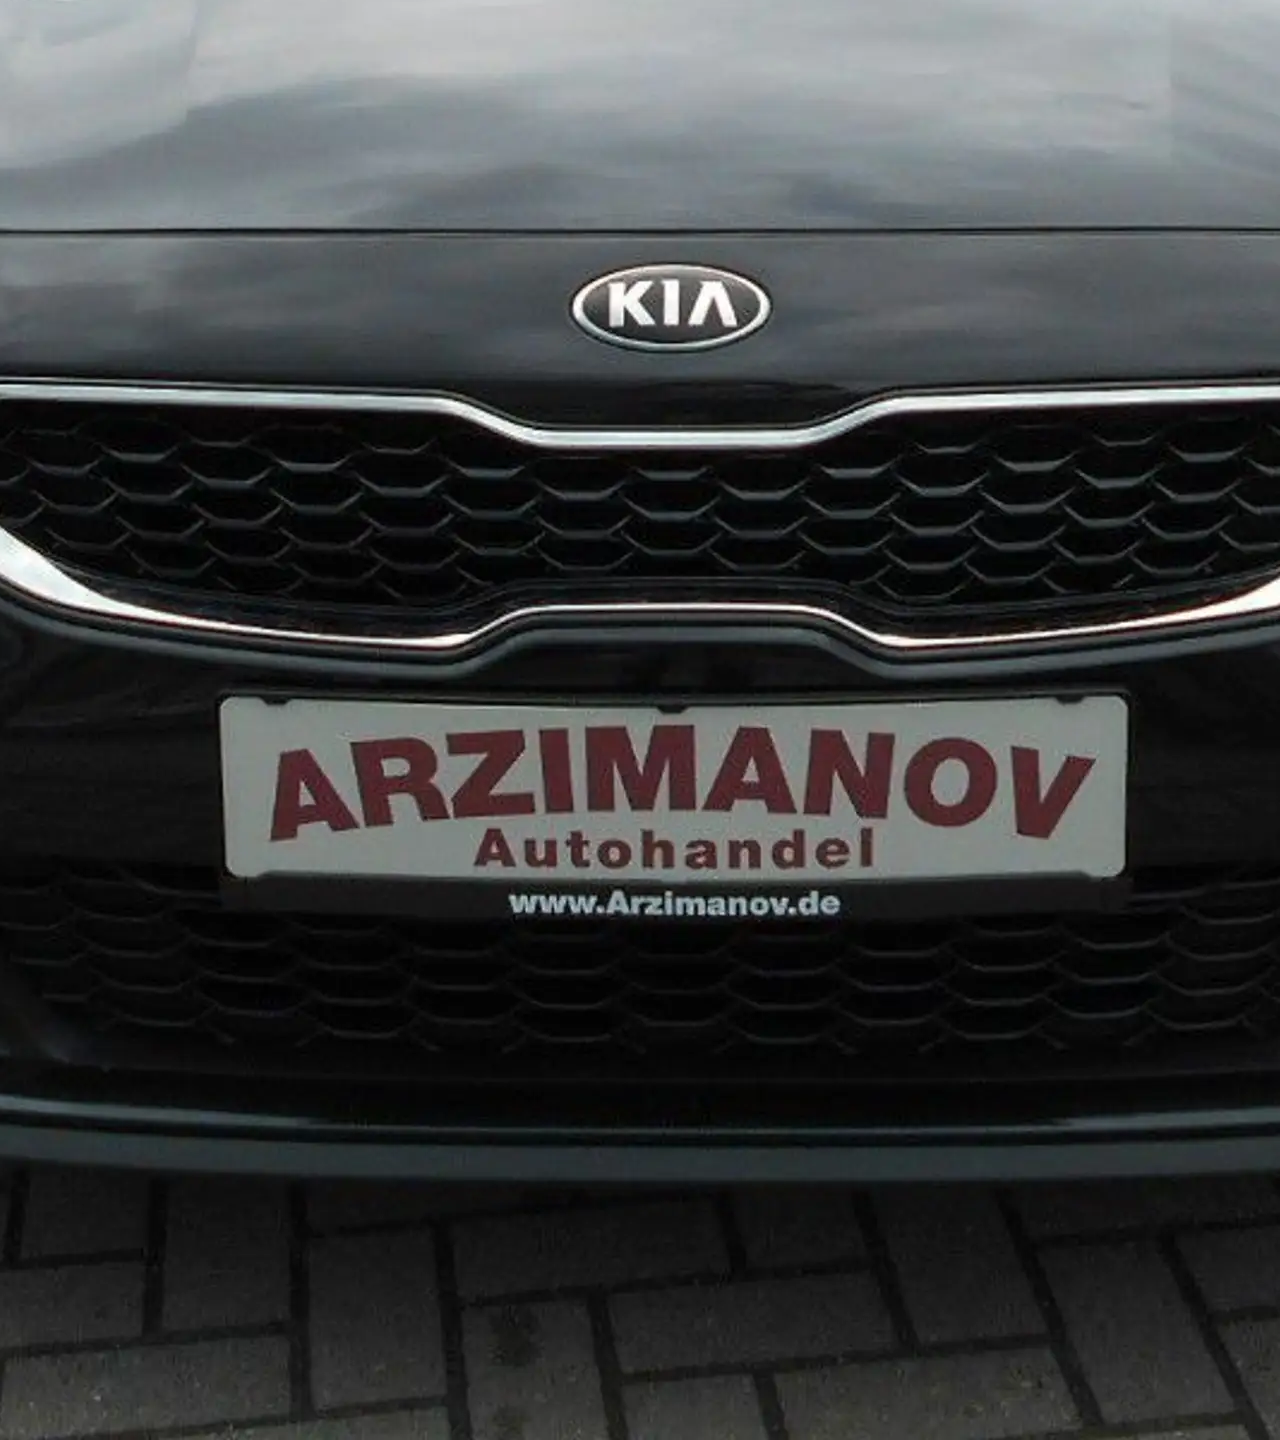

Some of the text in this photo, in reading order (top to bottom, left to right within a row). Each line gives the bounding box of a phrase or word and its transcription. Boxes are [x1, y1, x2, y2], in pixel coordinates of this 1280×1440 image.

[607, 278, 738, 328] KIA
[269, 723, 1096, 842] ARZIMANOV
[472, 827, 875, 871] Autohandel
[508, 888, 841, 919] www.Arzimanov.de
